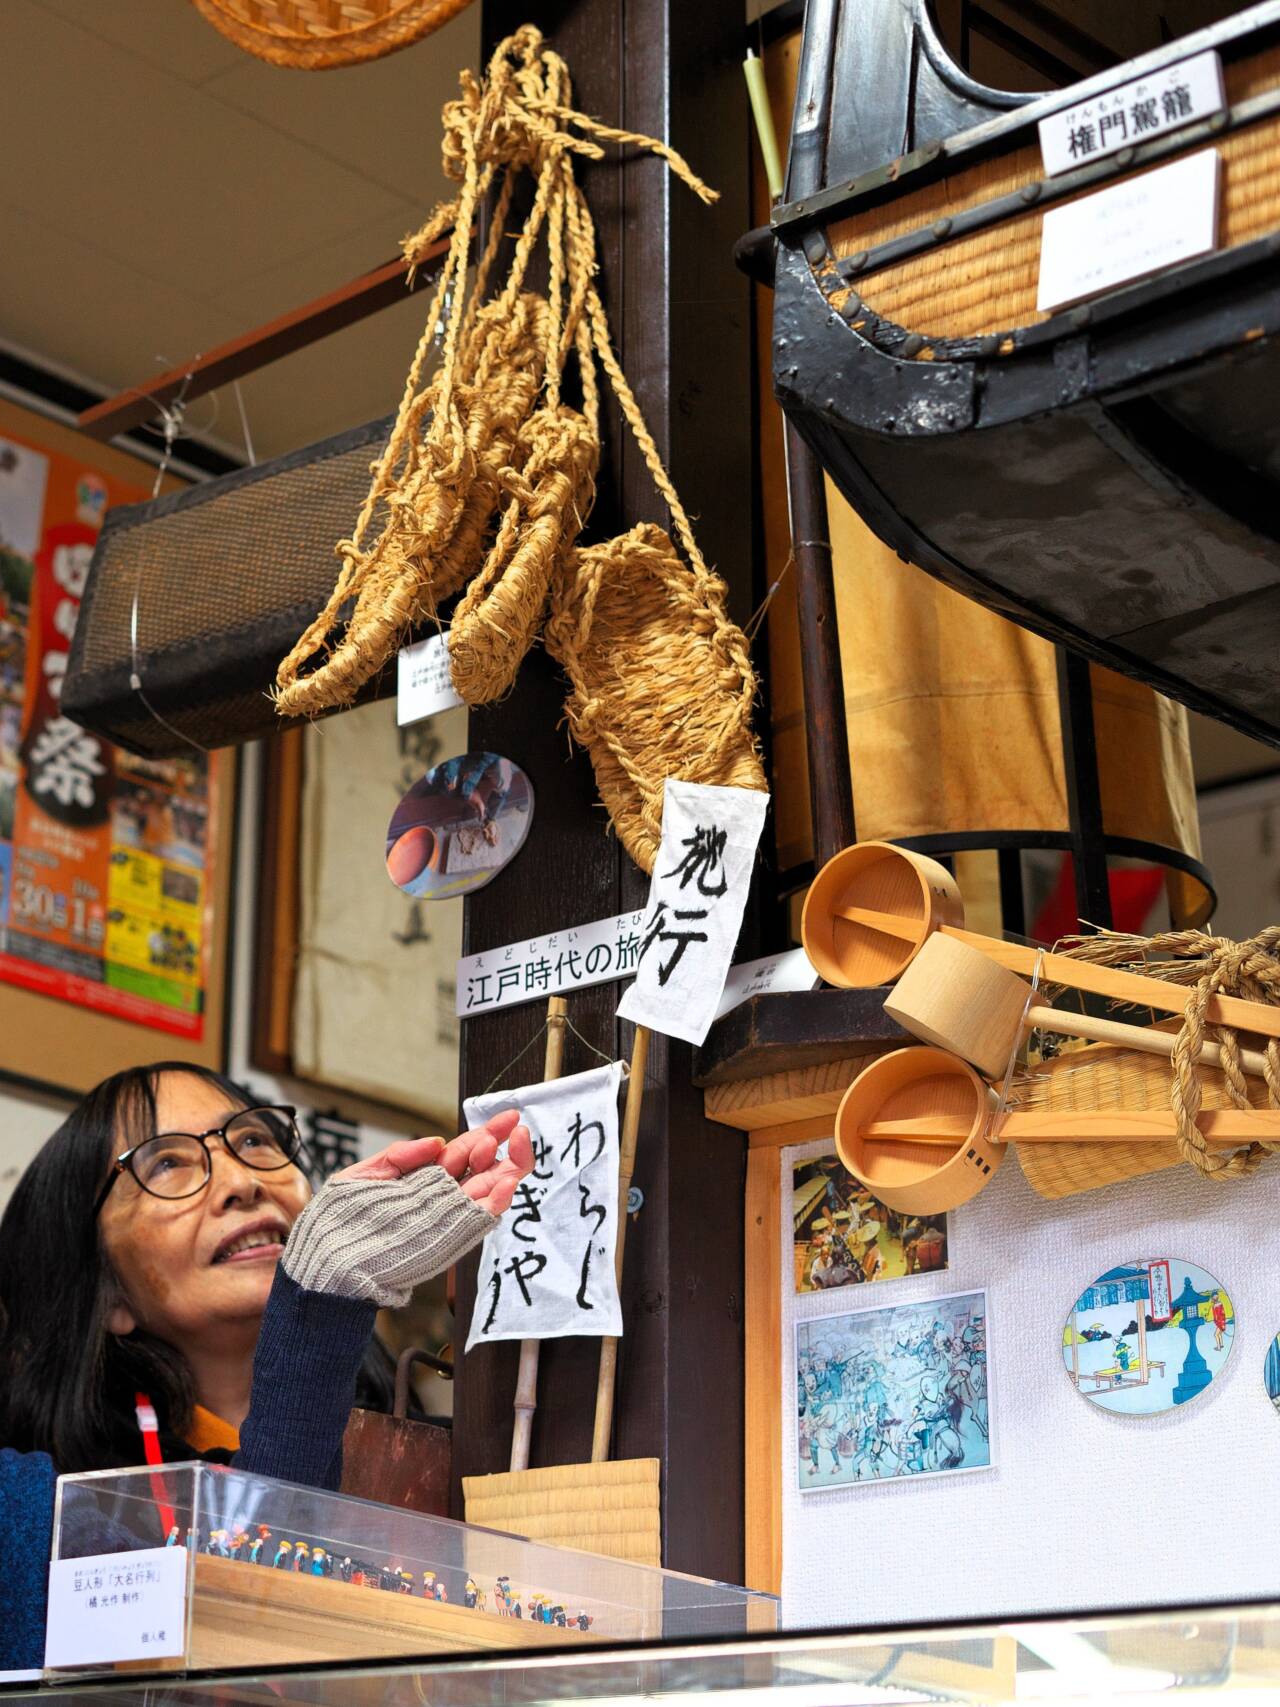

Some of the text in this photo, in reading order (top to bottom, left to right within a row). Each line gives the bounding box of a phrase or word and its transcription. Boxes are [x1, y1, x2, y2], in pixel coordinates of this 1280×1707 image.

[1067, 84, 1194, 159] 権門駕籠
[466, 931, 642, 1009] 江戸時代の旅
[475, 931, 578, 968] えどじだい
[559, 1111, 607, 1311] わらじ
